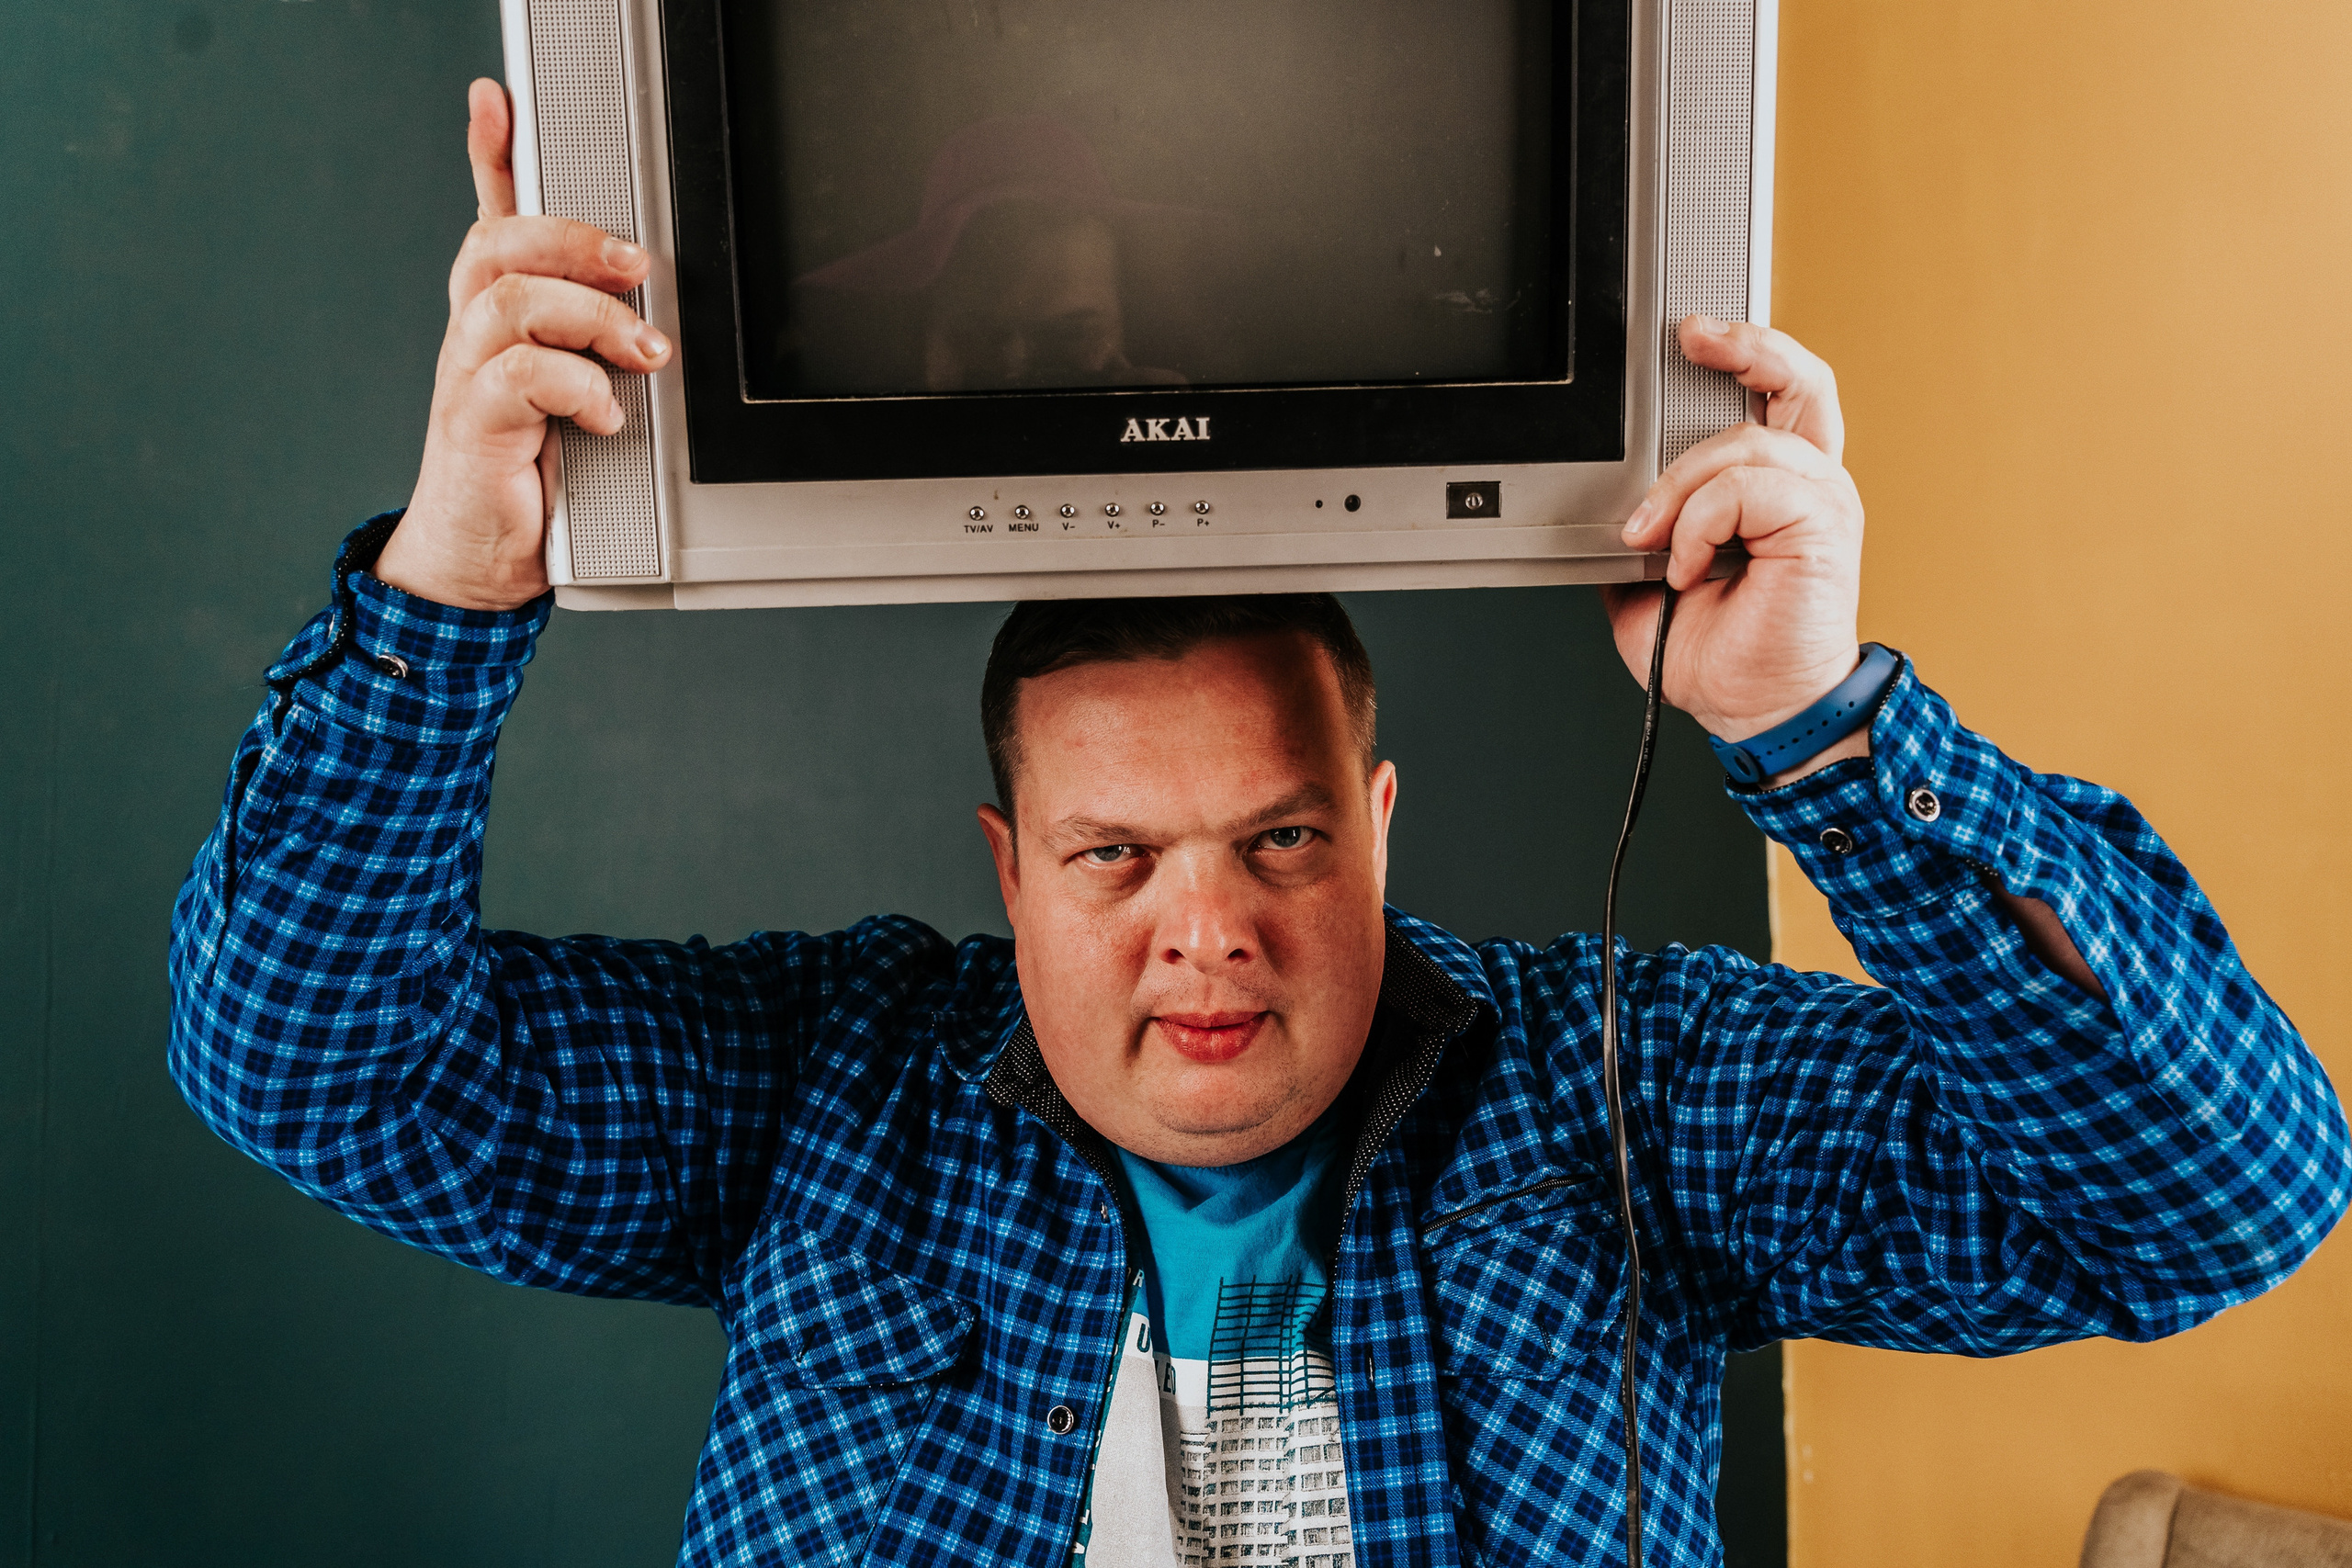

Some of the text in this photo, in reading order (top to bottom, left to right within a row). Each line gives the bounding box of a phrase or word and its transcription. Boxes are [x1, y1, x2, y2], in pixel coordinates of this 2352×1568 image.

[1120, 416, 1211, 443] AKAI
[1062, 522, 1076, 531] V-
[1107, 521, 1121, 529] V+
[1152, 519, 1166, 528] P-
[1196, 518, 1210, 527] P+
[964, 525, 994, 534] TV/AV
[1008, 523, 1039, 532] MENU
